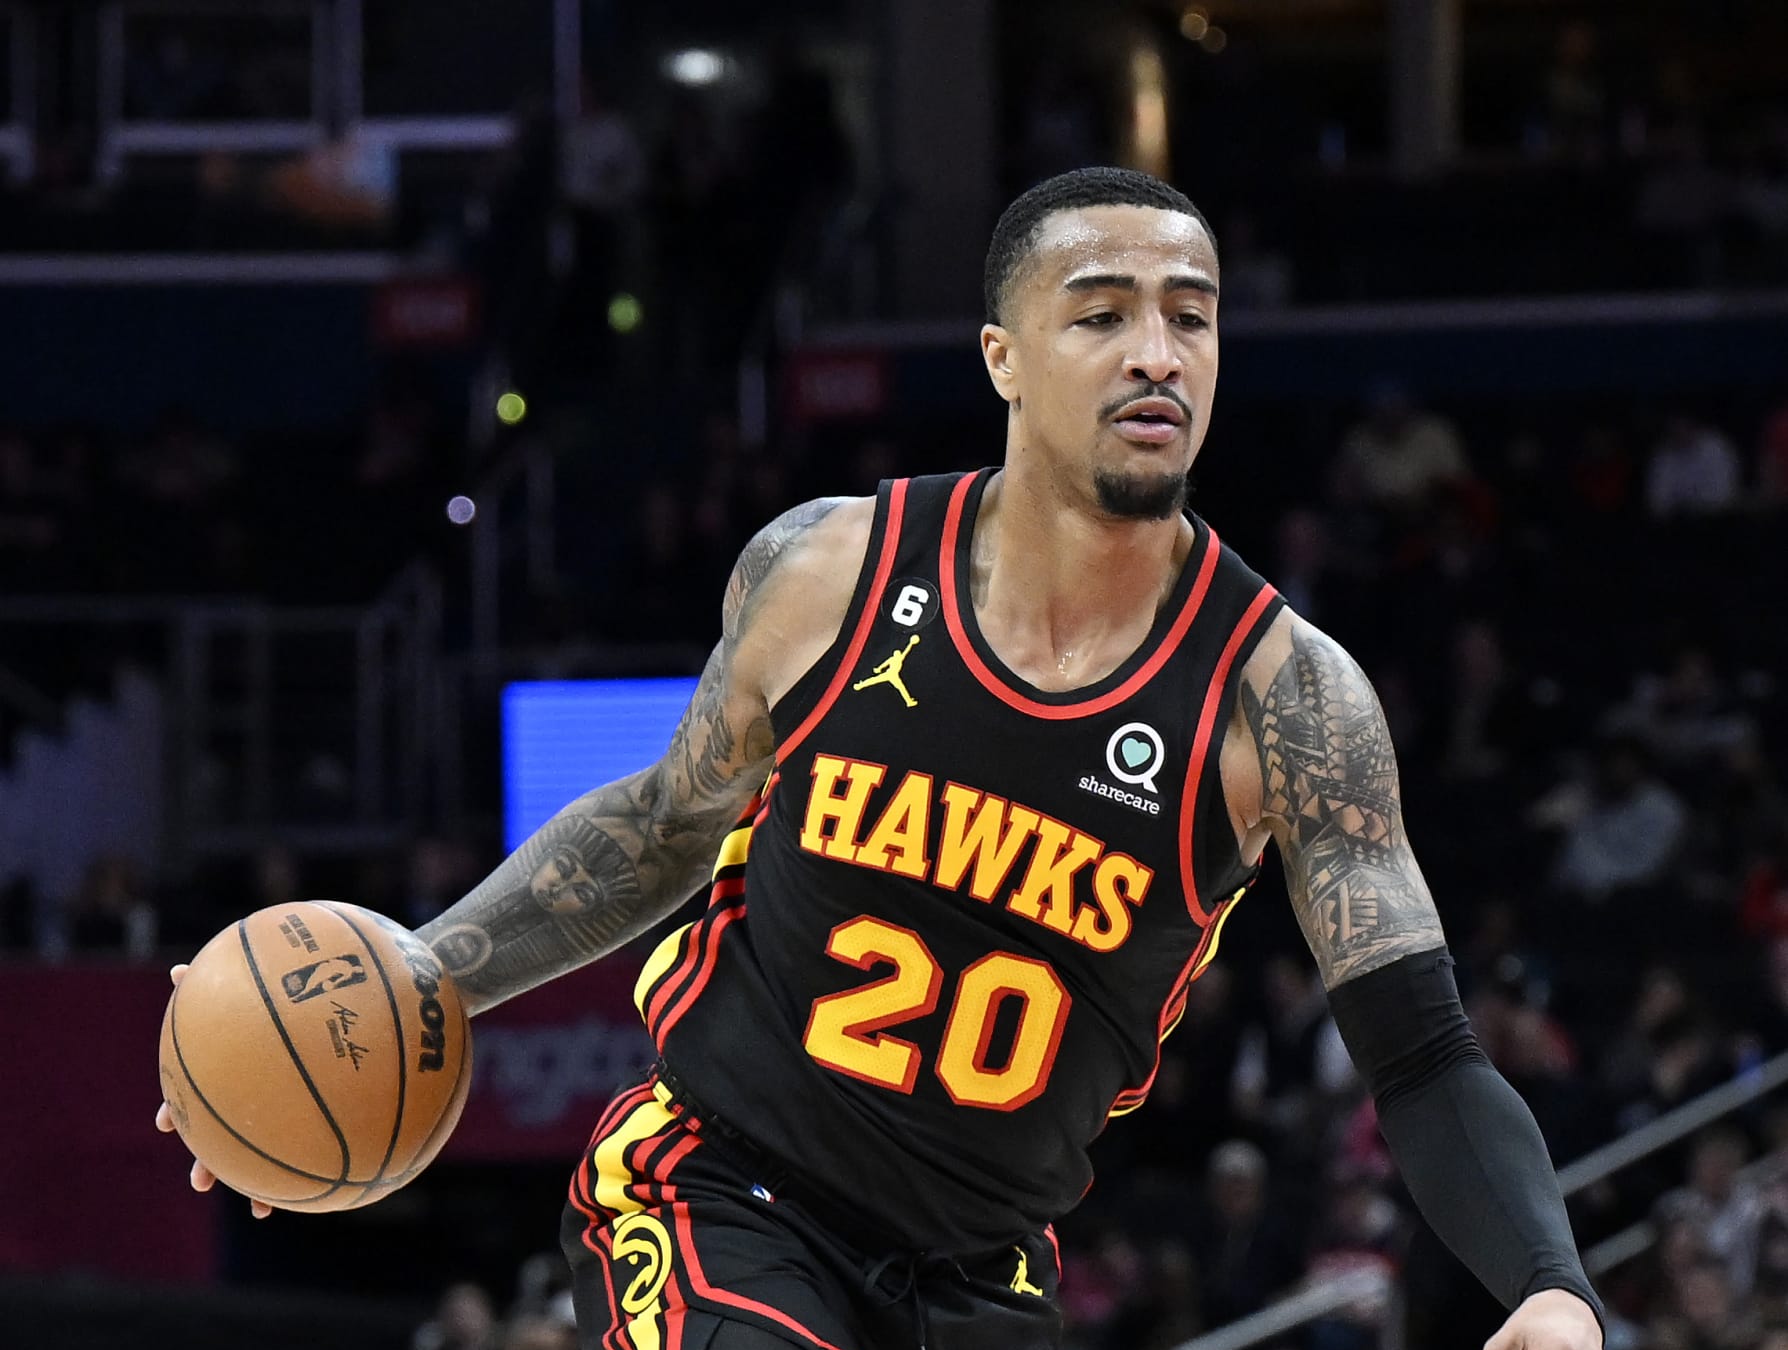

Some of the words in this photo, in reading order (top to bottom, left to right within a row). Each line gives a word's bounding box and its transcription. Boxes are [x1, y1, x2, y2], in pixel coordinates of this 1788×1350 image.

[892, 585, 929, 627] 6
[799, 752, 1155, 953] HAWKS
[1078, 775, 1161, 816] sharecare
[803, 914, 1073, 1112] 20
